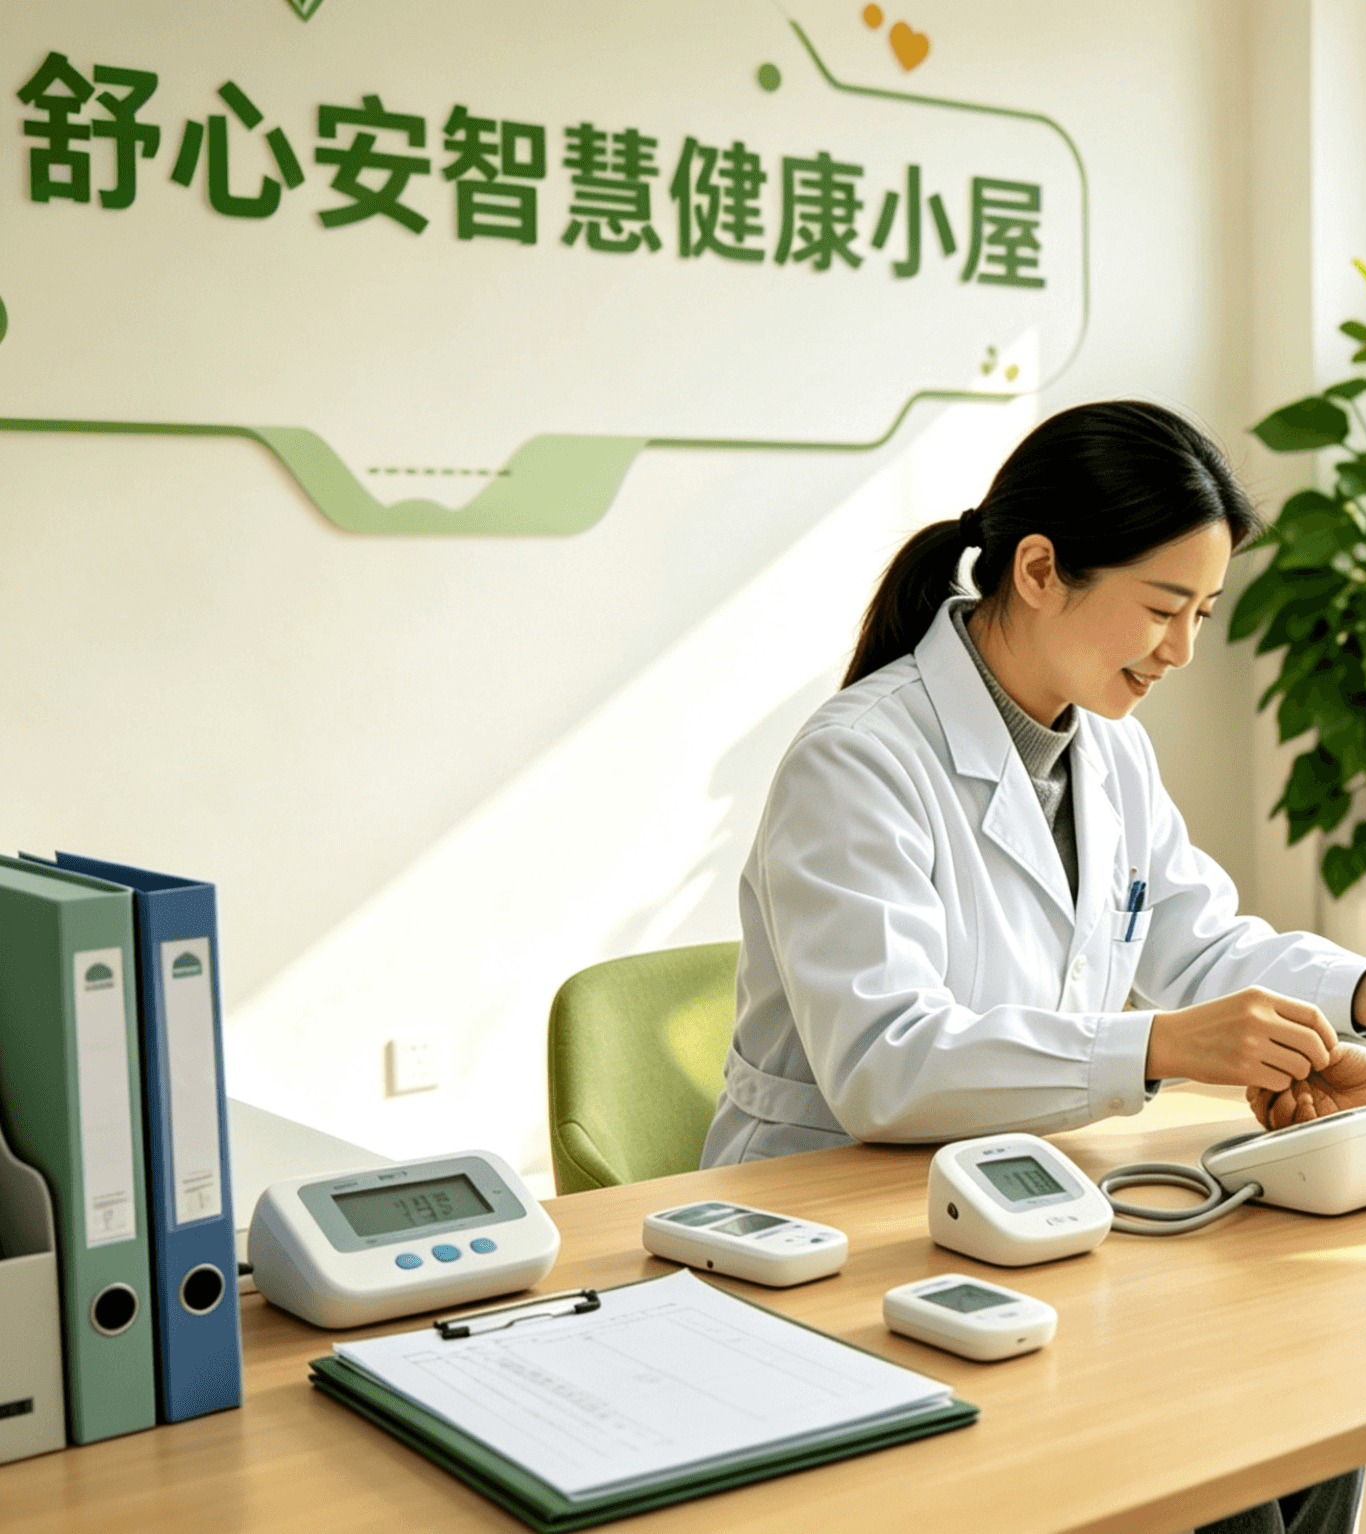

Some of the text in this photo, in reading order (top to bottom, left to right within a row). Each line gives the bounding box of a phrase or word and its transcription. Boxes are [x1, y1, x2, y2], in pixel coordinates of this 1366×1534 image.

[17, 51, 1047, 289] 舒心安智慧健康小屋
